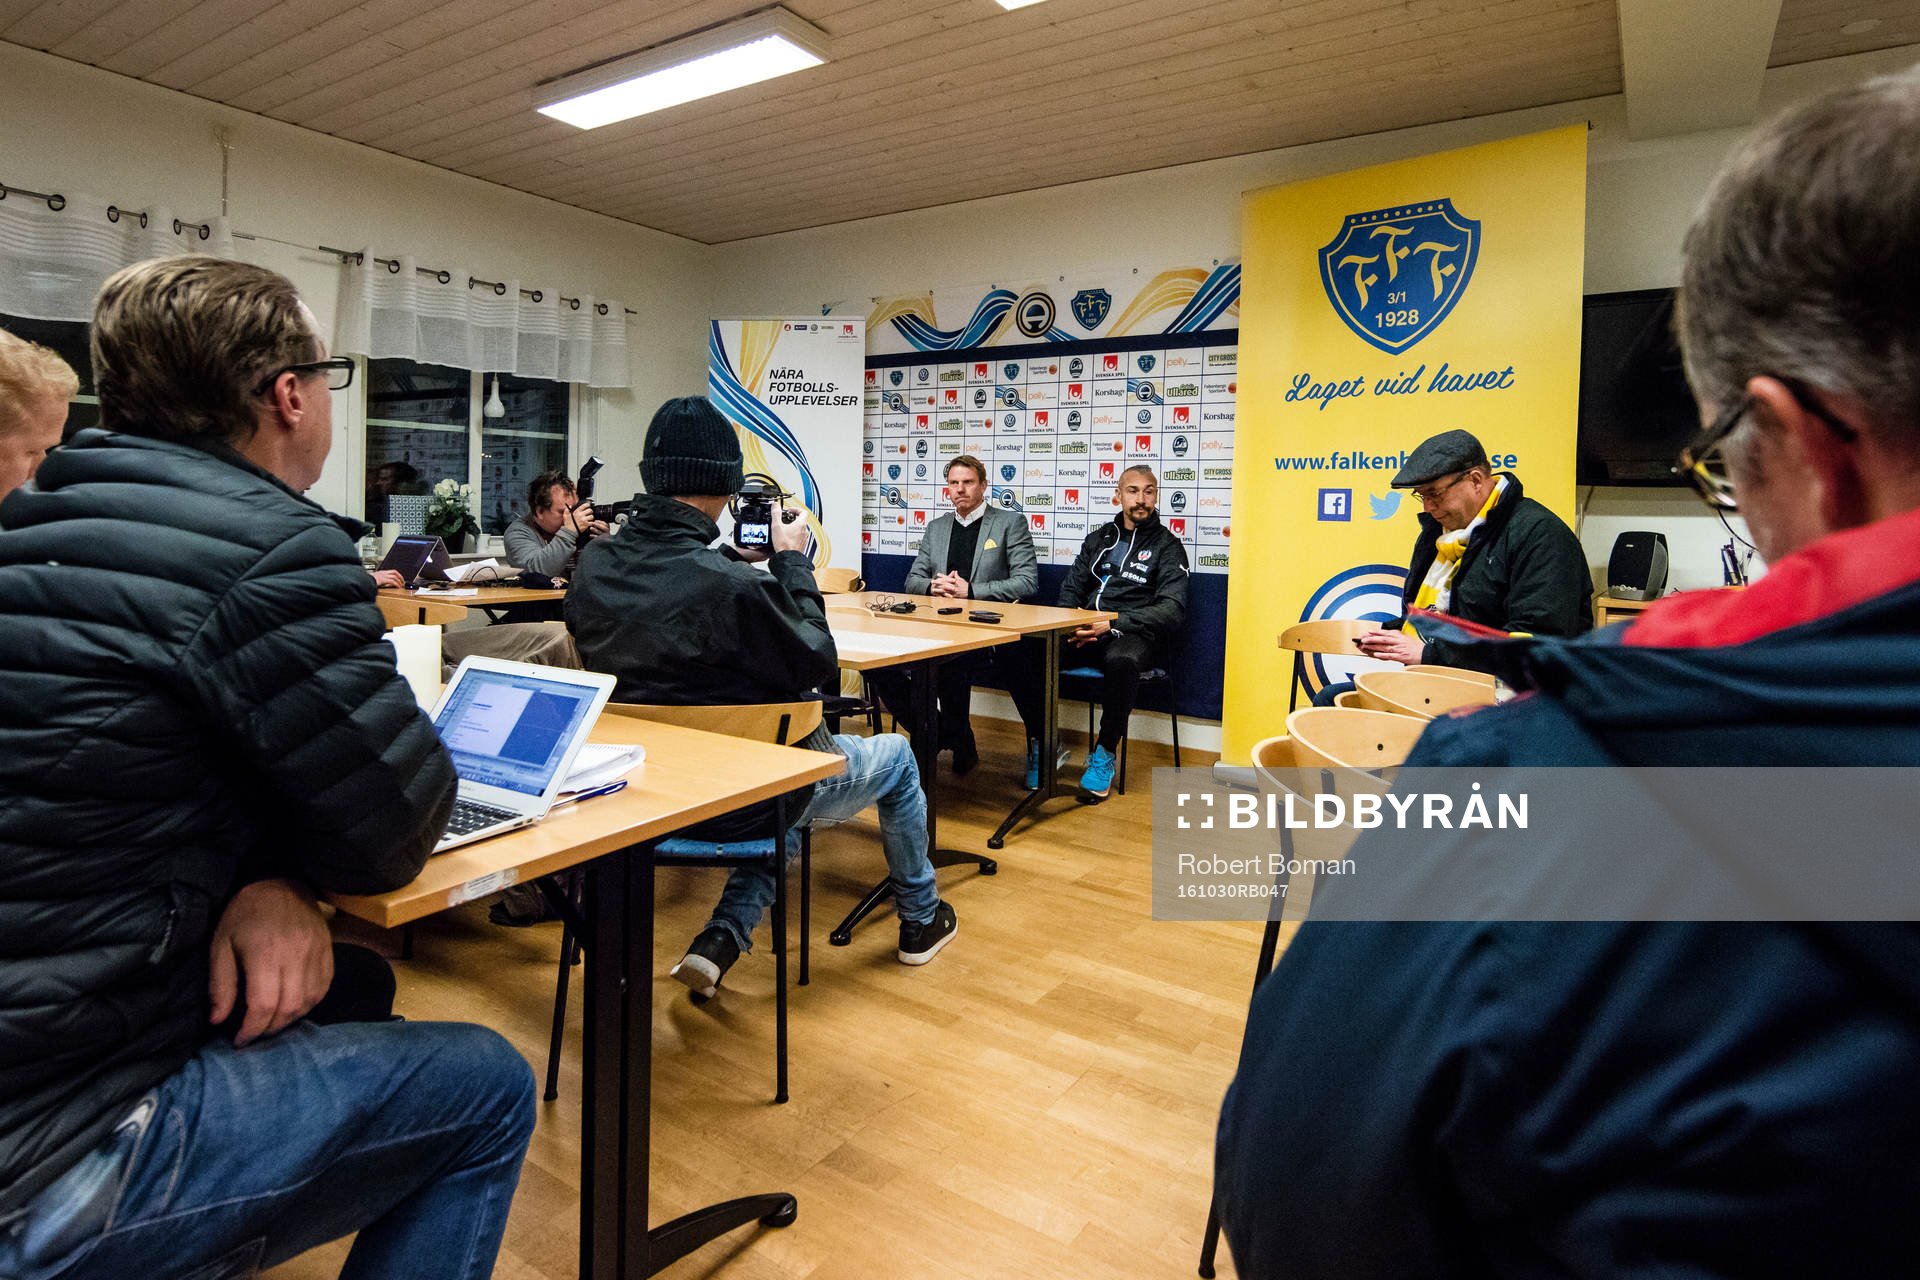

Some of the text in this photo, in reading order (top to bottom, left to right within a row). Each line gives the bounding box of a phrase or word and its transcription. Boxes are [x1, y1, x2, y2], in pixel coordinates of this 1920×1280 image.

[1387, 291, 1407, 304] 3/1
[1375, 309, 1420, 328] 1928
[769, 366, 804, 379] NÄRA
[769, 382, 839, 393] FOTBOLLS-
[1167, 386, 1198, 397] Ullared
[1285, 363, 1515, 411] Laget vid havet
[769, 396, 858, 406] UPPLEVELSER
[1204, 412, 1235, 421] Korshag
[1164, 471, 1195, 480] Ullared
